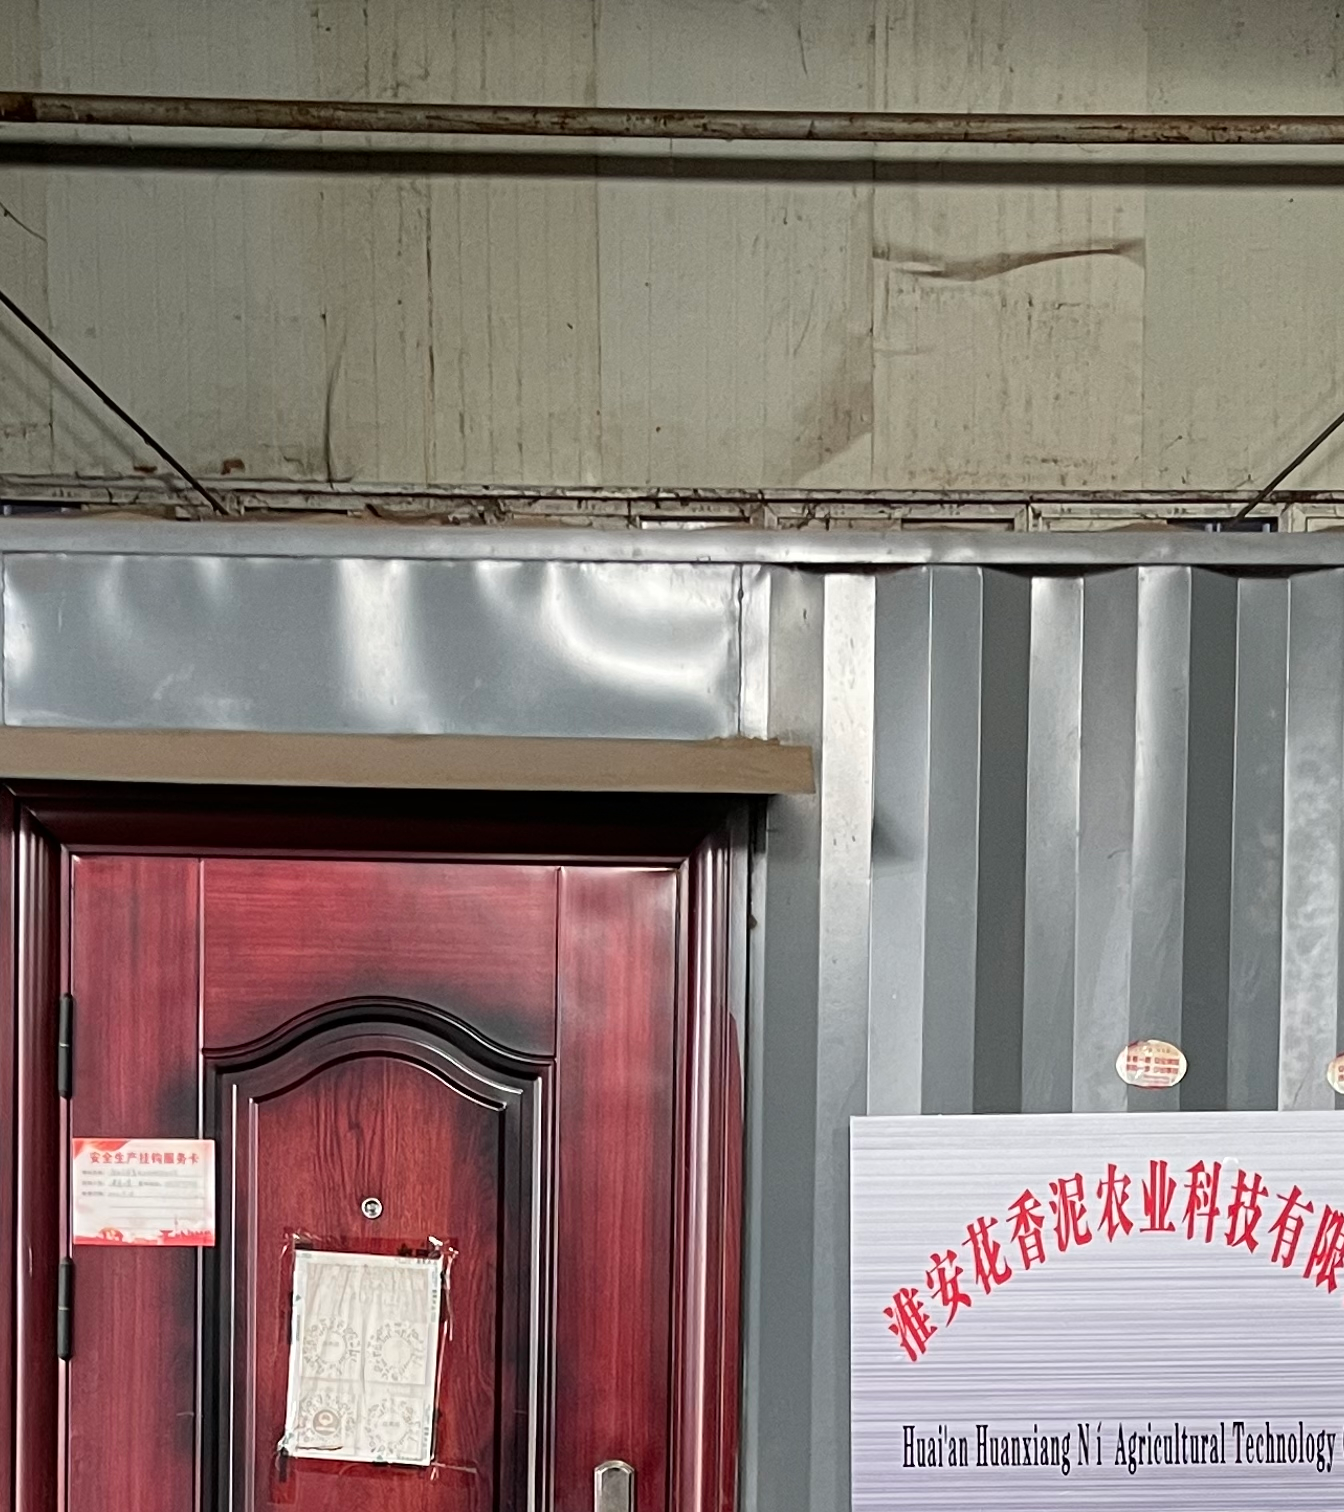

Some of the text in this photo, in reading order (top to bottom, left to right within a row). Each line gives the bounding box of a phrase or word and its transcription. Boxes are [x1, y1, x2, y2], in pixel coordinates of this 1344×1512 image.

[89, 1151, 199, 1165] 安全生产挂钩服务卡
[902, 1424, 969, 1468] Huai'an
[976, 1423, 1071, 1476] Huanxiang
[1114, 1422, 1226, 1475] Agricultural
[1232, 1421, 1336, 1473] Technology
